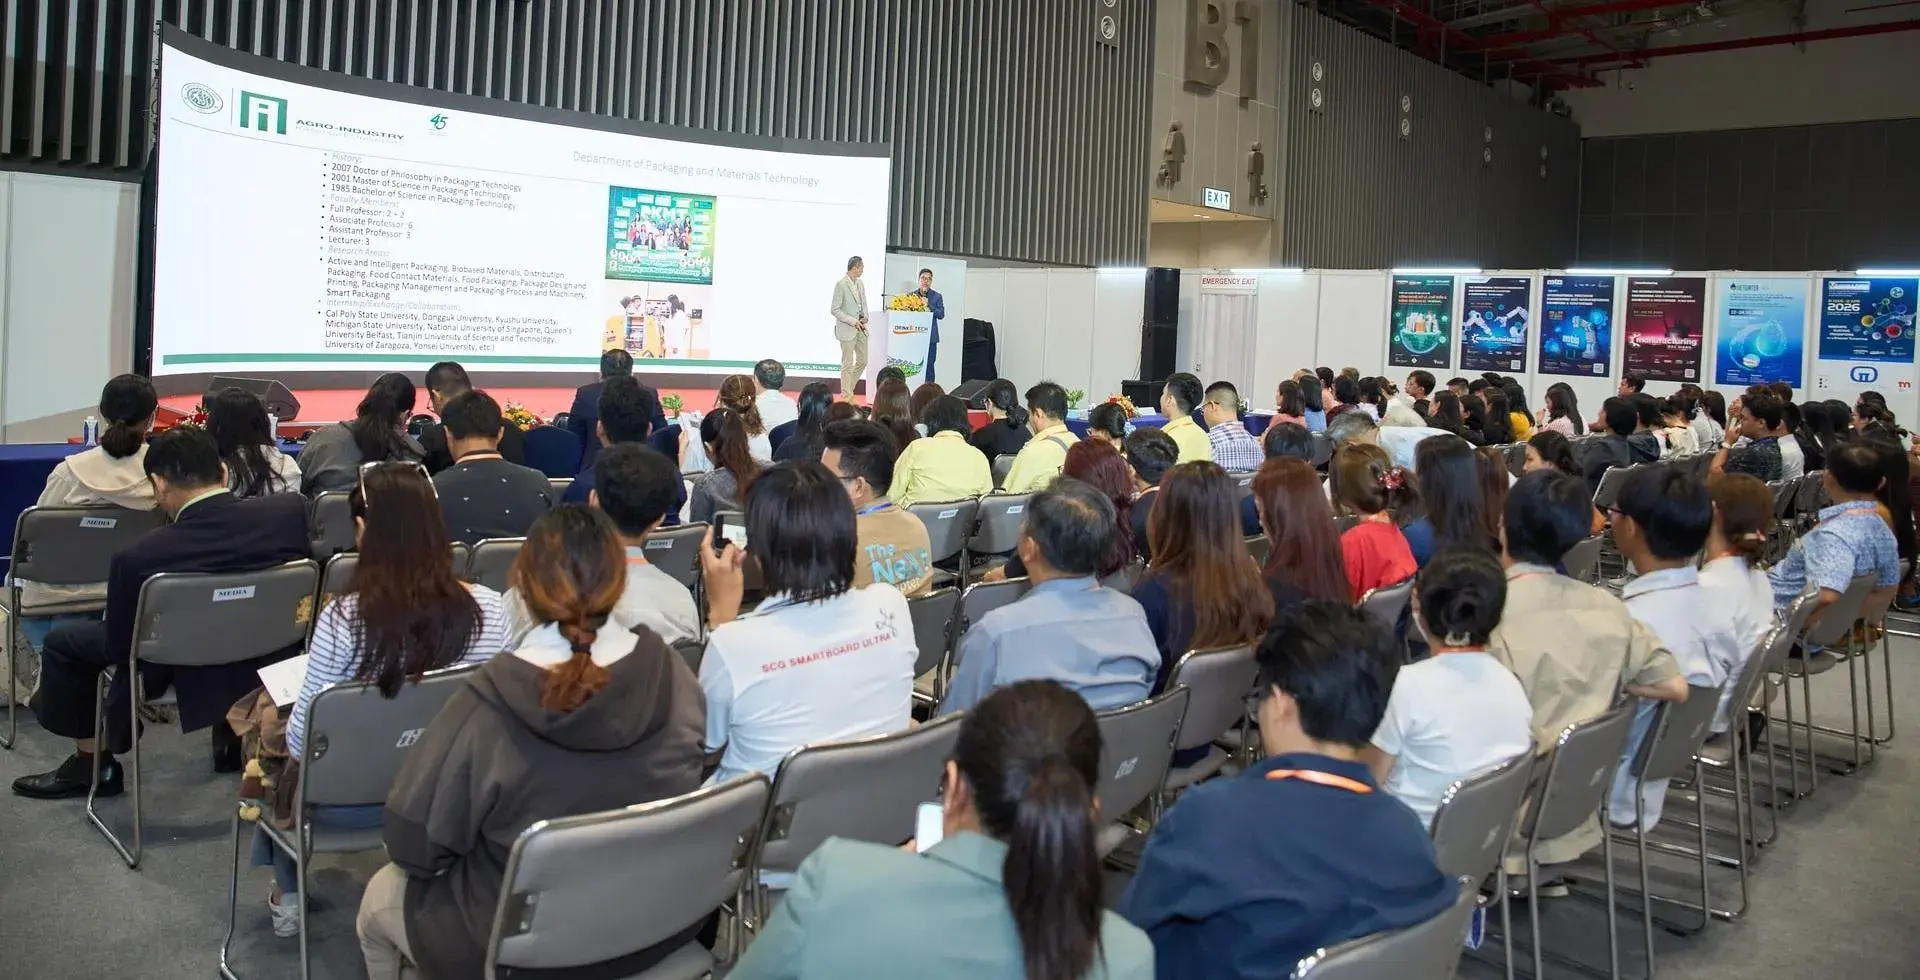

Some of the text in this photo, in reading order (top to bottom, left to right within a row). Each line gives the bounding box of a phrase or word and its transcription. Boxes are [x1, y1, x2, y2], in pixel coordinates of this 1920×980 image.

[296, 119, 405, 140] AGRO-INDUSTRY
[430, 113, 448, 130] 45
[331, 162, 522, 192] 2007 Doctor of Philosophy in Packaging Technology
[573, 150, 820, 188] Department of Packaging and Materials Technology
[331, 173, 351, 183] 2001
[352, 175, 380, 186] Master
[381, 179, 391, 187] of
[392, 180, 421, 190] Science
[431, 184, 469, 197] Packaging
[469, 188, 510, 200] Technology
[331, 183, 351, 193] 1985
[352, 185, 386, 197] Bachelor
[387, 190, 396, 198] of
[397, 190, 427, 201] Science
[437, 194, 474, 207] Packaging
[475, 198, 516, 211] Technology
[1207, 190, 1229, 206] EXIT
[330, 203, 344, 213] Full
[346, 205, 385, 217] Professor:
[386, 209, 392, 217] 2
[399, 211, 405, 219] 2
[329, 214, 366, 225] Associate
[328, 225, 364, 235] Assistant
[328, 235, 364, 245] Lecturer:
[327, 257, 353, 266] Active
[353, 258, 369, 267] and
[370, 260, 409, 270] Intelligent
[451, 264, 485, 274] Biobased
[523, 269, 565, 279] Distribution
[327, 267, 368, 279] Packaging,
[369, 270, 390, 279] Food
[390, 271, 421, 281] Contact
[461, 275, 480, 284] Food
[520, 279, 548, 289] Package
[549, 280, 573, 290] Design
[573, 281, 587, 290] and
[1202, 277, 1240, 285] EMERGENCY
[326, 278, 360, 289] Printing,
[361, 280, 400, 291] Packaging
[401, 282, 453, 293] Management
[453, 284, 468, 293] and
[469, 285, 505, 296] Packaging
[506, 287, 533, 297] Process
[533, 289, 548, 297] and
[326, 288, 391, 300] Smart Packaging
[1827, 303, 1861, 312] 2026
[325, 309, 338, 318] Cal
[340, 310, 357, 319] Poly
[358, 310, 379, 319] State
[380, 311, 420, 321] University,
[422, 312, 455, 323] Dongguk
[456, 314, 494, 324] University,
[495, 315, 521, 325] Kyushu
[325, 319, 361, 330] Michigan
[363, 321, 384, 329] State
[385, 321, 425, 332] University,
[427, 322, 459, 332] National
[460, 324, 496, 333] University
[497, 324, 505, 332] of
[506, 325, 543, 335] Singapore,
[325, 330, 557, 344] University Belfast, Tianjin University of Science and Technology,
[1635, 335, 1697, 347] manufacturing
[325, 340, 364, 350] University
[365, 340, 374, 349] of
[375, 341, 412, 351] Zaragoza,
[413, 341, 437, 350] Yonsei
[439, 342, 478, 352] University,
[864, 543, 897, 561] The
[217, 589, 247, 597] MEDIA
[761, 632, 892, 673] SCG SMARTBOARD ULTRA
